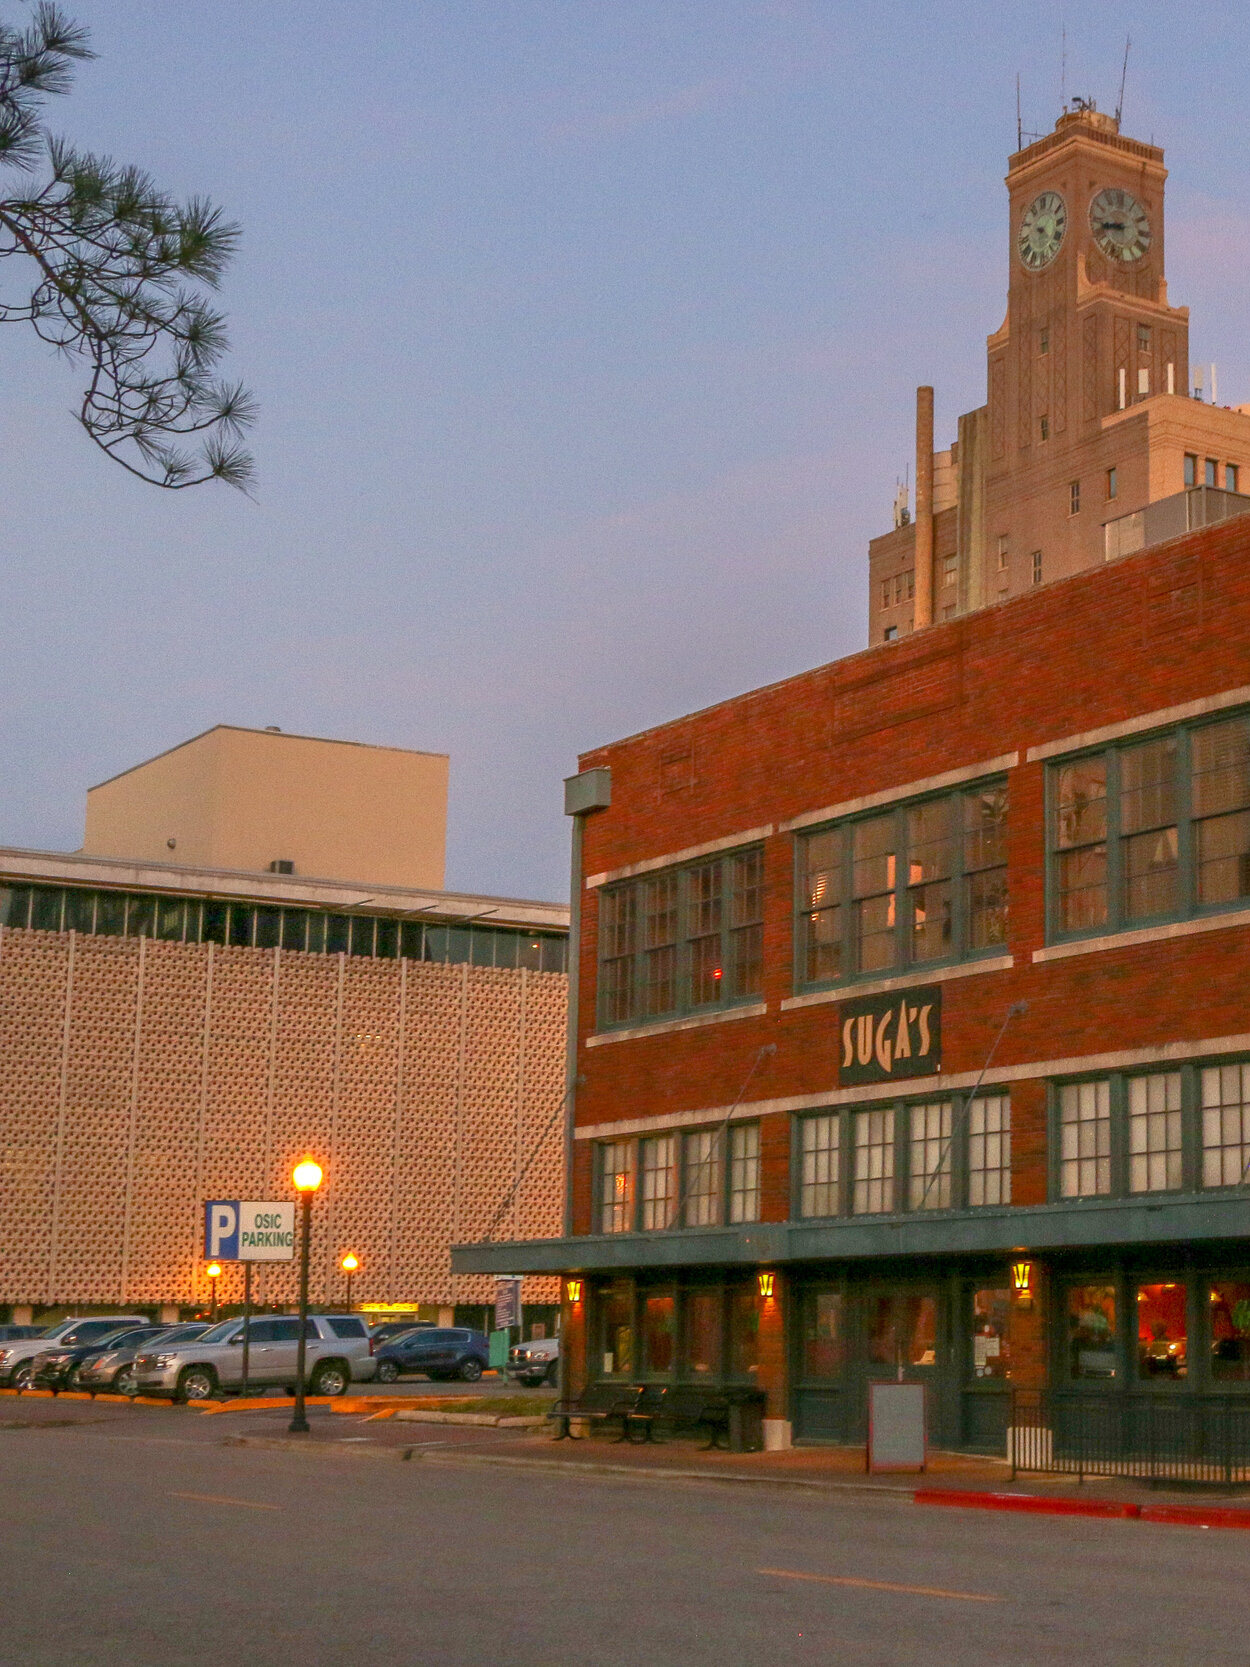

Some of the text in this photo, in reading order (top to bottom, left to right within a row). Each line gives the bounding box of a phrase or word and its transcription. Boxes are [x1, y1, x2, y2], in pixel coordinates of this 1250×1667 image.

[842, 999, 933, 1073] SUGA'S
[211, 1205, 236, 1256] P
[254, 1213, 282, 1229] OSIC
[241, 1231, 293, 1247] PARKING
